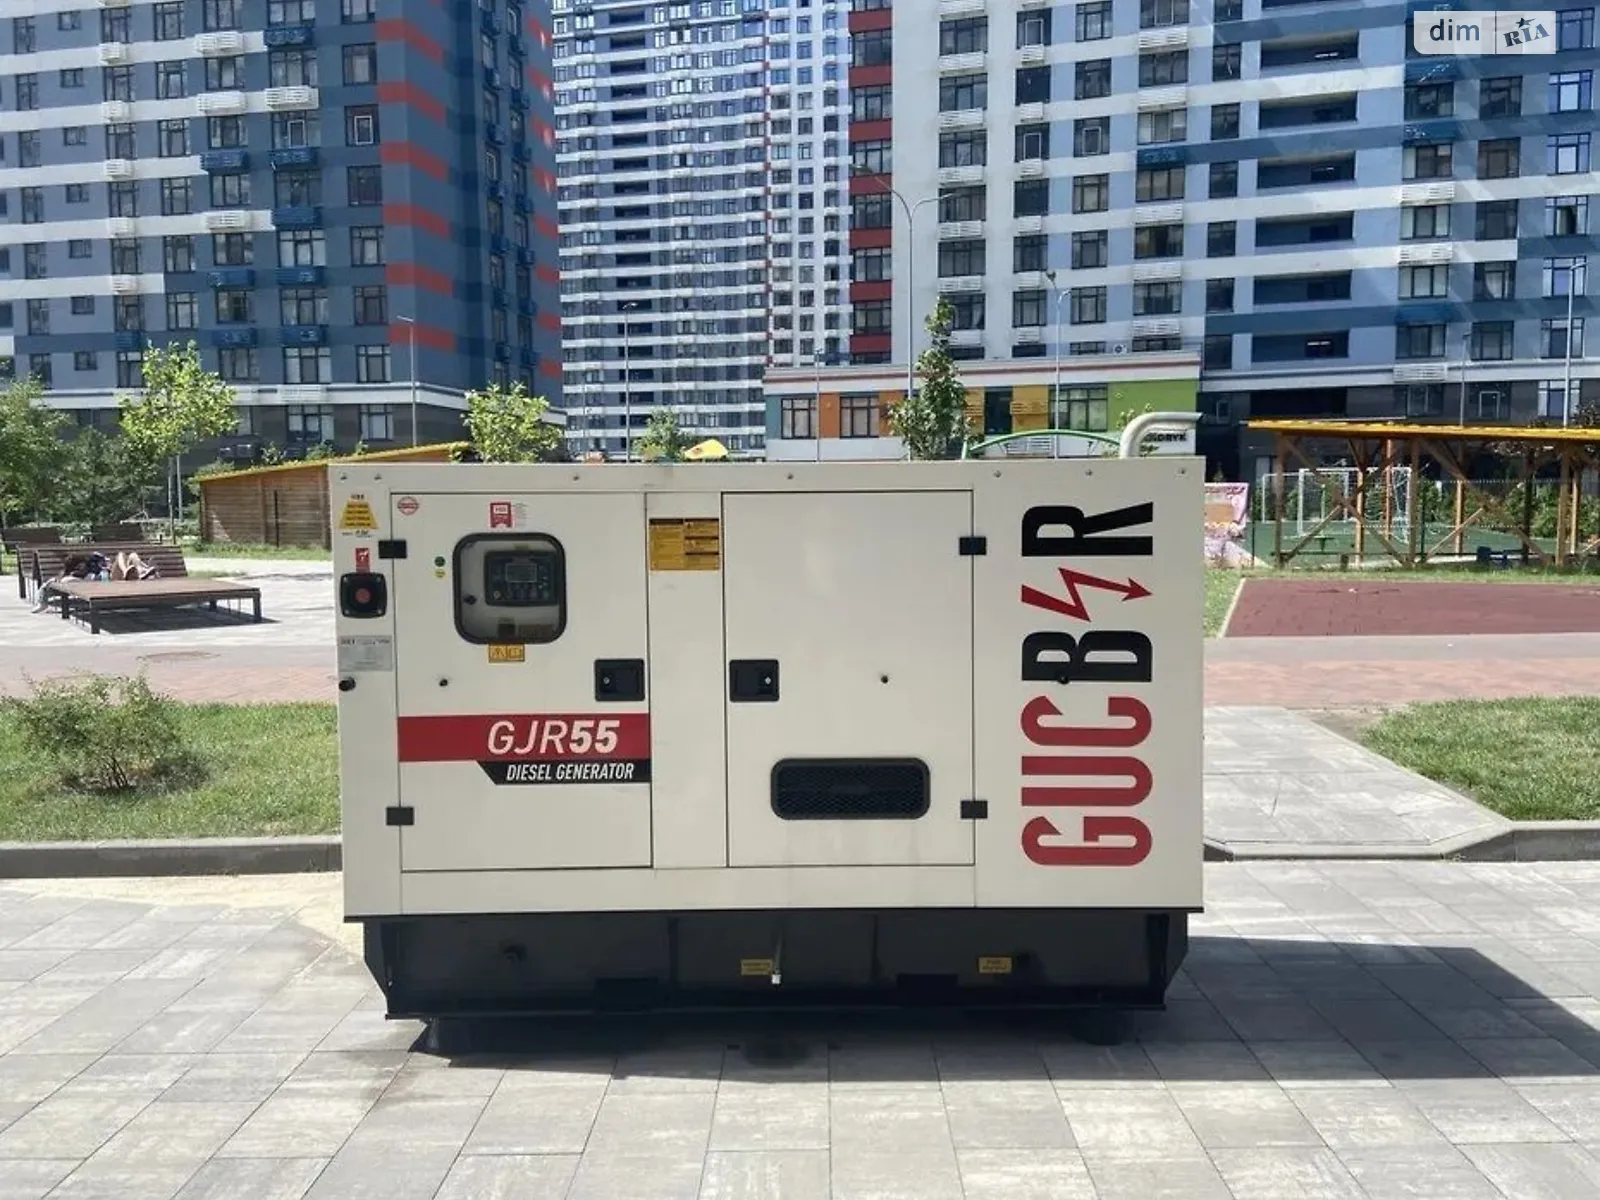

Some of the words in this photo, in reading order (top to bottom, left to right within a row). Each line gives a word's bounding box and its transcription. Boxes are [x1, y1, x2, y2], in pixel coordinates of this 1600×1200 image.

[487, 719, 620, 755] GJR55
[506, 764, 552, 781] DIESEL
[556, 762, 634, 780] GENERATOR
